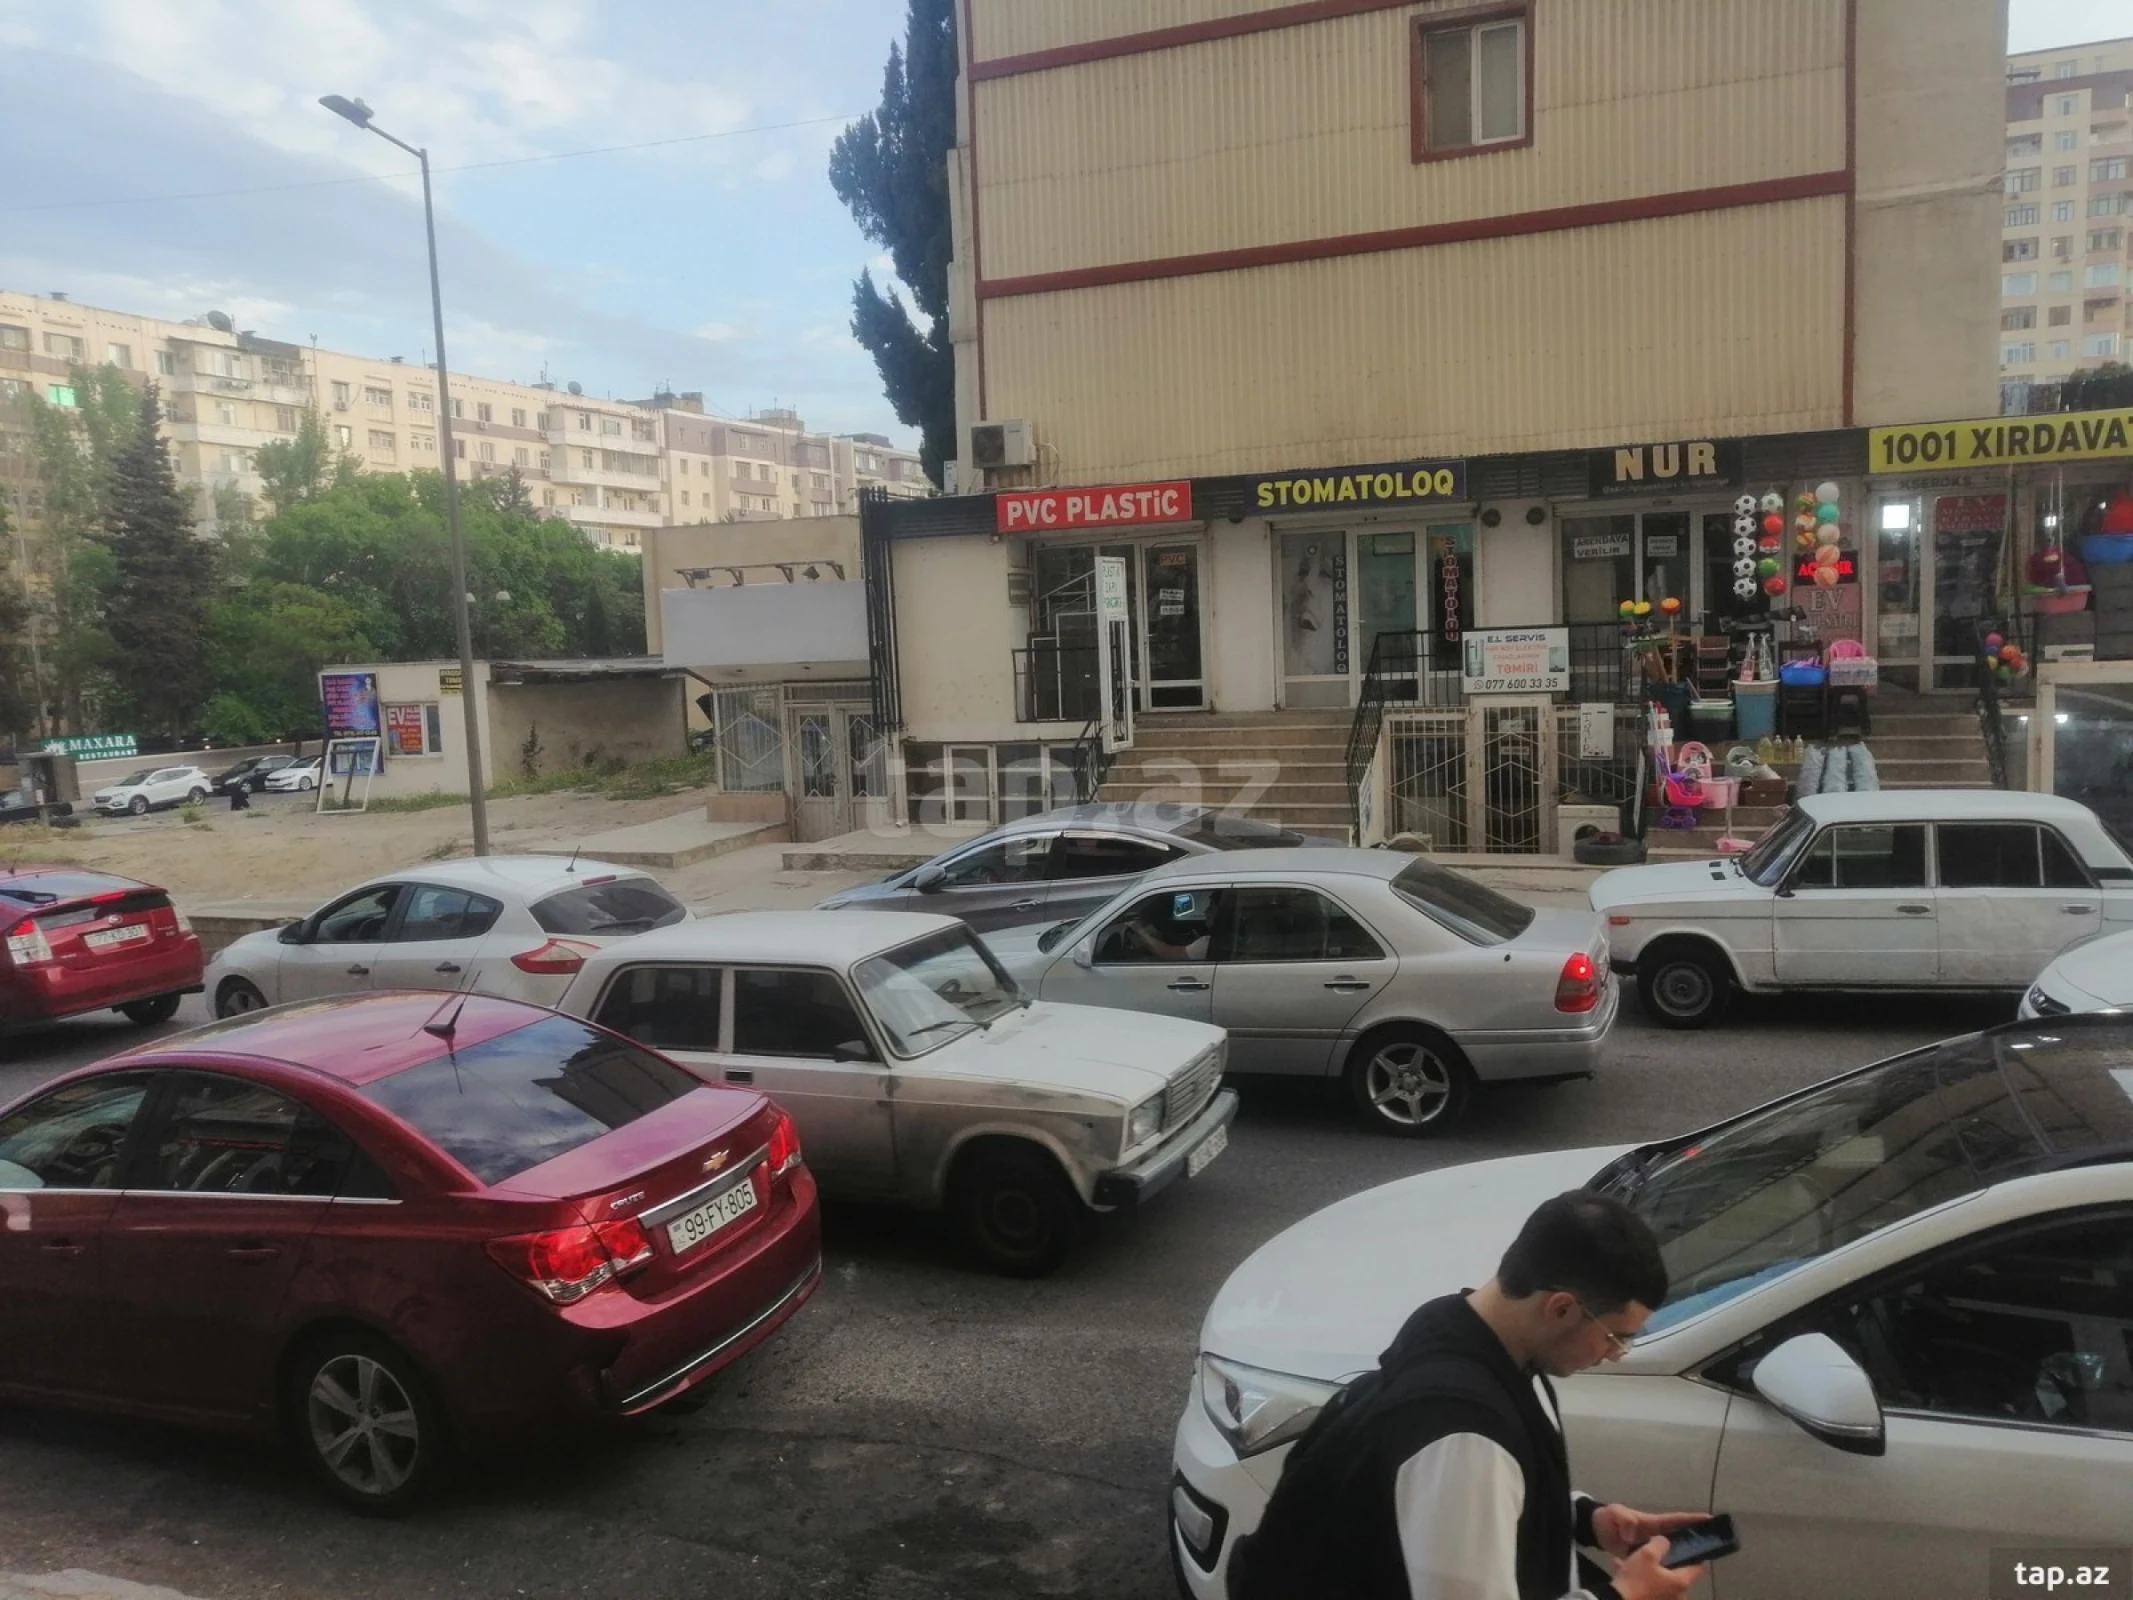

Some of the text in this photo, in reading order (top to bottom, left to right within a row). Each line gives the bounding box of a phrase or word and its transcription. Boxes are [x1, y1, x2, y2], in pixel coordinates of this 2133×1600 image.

[1882, 430, 1957, 465] 1001
[1615, 442, 1718, 481] NUR
[1256, 468, 1456, 508] STOMATOLOQ
[1006, 498, 1057, 526] PVC
[1810, 588, 1845, 612] EV
[1334, 556, 1348, 673] STOMATOLOQ
[1496, 662, 1538, 674] TƏMİRİ
[1485, 677, 1558, 690] 077 600 33 35
[387, 707, 406, 725] EV
[69, 735, 137, 751] MAXARA
[79, 748, 138, 760] RESTAURANT
[684, 1183, 754, 1241] 99-FY-805
